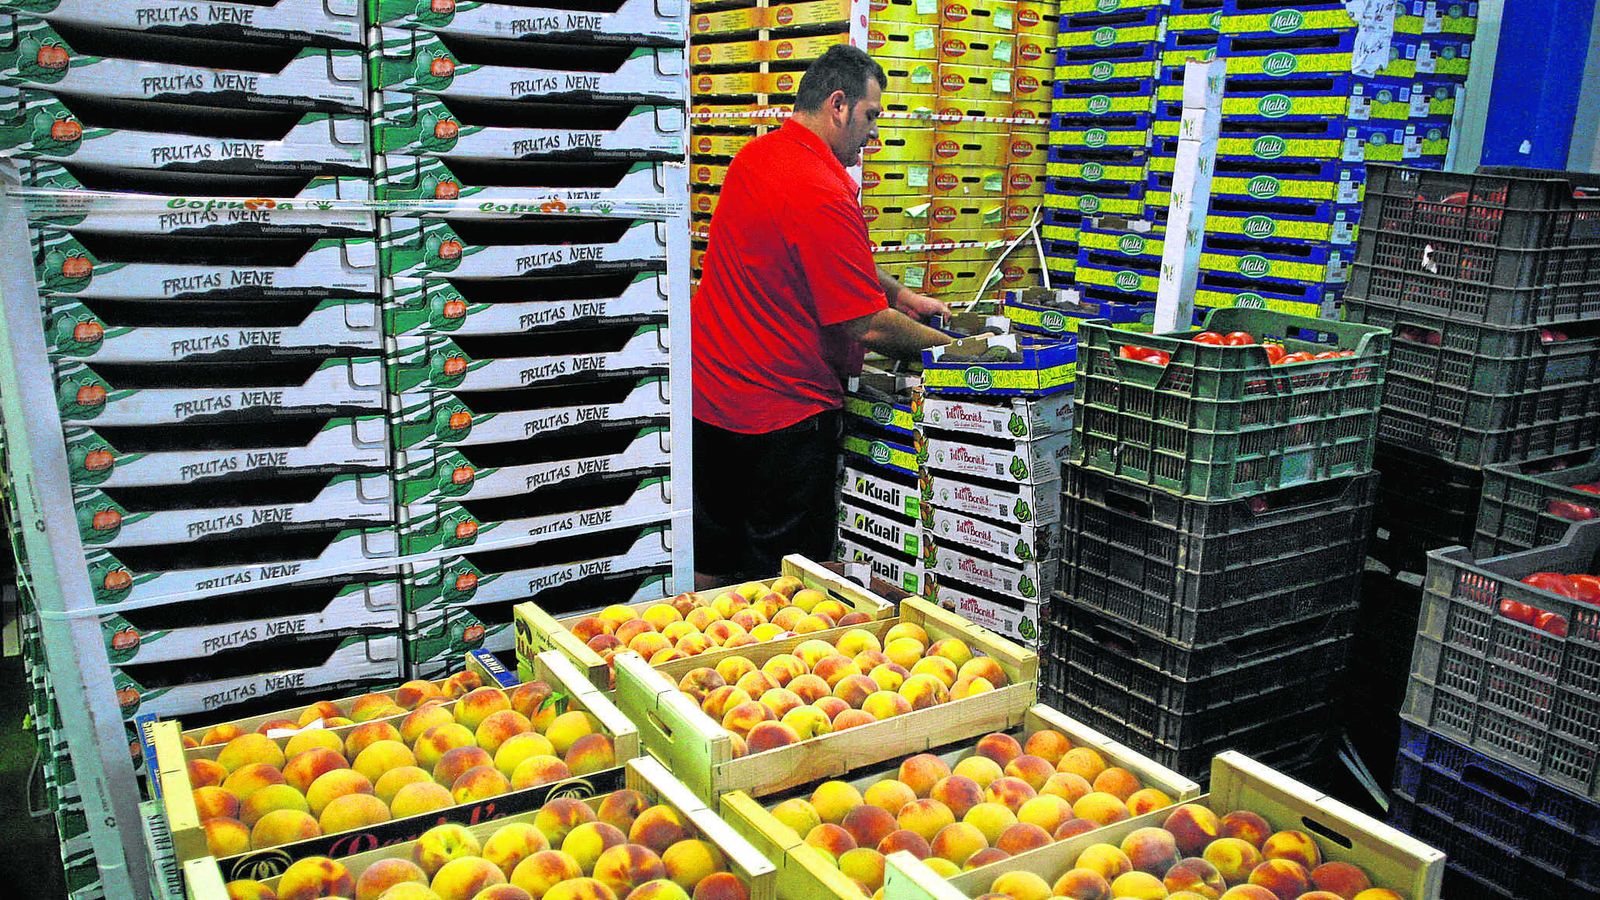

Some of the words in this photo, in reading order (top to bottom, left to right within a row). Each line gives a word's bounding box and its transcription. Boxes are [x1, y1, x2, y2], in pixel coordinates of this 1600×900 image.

[136, 7, 198, 25] FRUTAS
[208, 5, 253, 24] NENE
[511, 16, 559, 34] FRUTAS
[566, 14, 602, 29] NENE
[1272, 14, 1300, 28] Malki
[1265, 57, 1293, 71] Malki
[141, 75, 203, 93] FRUTAS
[213, 73, 258, 91] NENE
[510, 77, 558, 95] FRUTAS
[565, 74, 600, 89] NENE
[1260, 99, 1288, 112] Malki
[151, 145, 211, 163] FRUTAS
[221, 142, 264, 158] NENE
[512, 135, 560, 154] FRUTAS
[567, 133, 602, 147] NENE
[1255, 141, 1282, 153] Malki
[1250, 180, 1277, 192] Malki
[1245, 220, 1272, 232] Malki
[1121, 238, 1143, 250] Malki
[516, 250, 562, 271] FRUTAS
[569, 247, 603, 260] NENE
[1240, 259, 1267, 271] Malki
[163, 273, 221, 295] FRUTAS
[230, 270, 274, 286] NENE
[1117, 274, 1139, 286] Malki
[1235, 296, 1263, 308] Malki
[519, 307, 565, 328] FRUTAS
[572, 303, 606, 316] NENE
[1043, 314, 1064, 327] Malki
[172, 334, 229, 356] FRUTAS
[239, 331, 281, 345] NENE
[520, 362, 565, 383] FRUTAS
[572, 357, 606, 370] NENE
[968, 371, 990, 384] Malki
[174, 395, 231, 418] FRUTAS
[241, 391, 283, 406] NENE
[524, 413, 569, 435] FRUTAS
[576, 407, 609, 421] NENE
[871, 444, 889, 457] Malki
[180, 457, 237, 480] FRUTAS
[246, 452, 288, 467] NENE
[526, 468, 570, 489] FRUTAS
[577, 459, 610, 474] NENE
[864, 482, 900, 507] Kuali
[187, 513, 243, 537] FRUTAS
[252, 508, 293, 524] NENE
[580, 510, 612, 525] NENE
[864, 517, 900, 544] Kuali
[528, 568, 573, 593] FRUTAS
[579, 561, 611, 576] NENE
[202, 628, 257, 654] FRUTAS
[266, 619, 306, 636] NENE
[202, 684, 256, 711] FRUTAS
[265, 674, 304, 690] NENE
[149, 813, 173, 852] FRUITS
